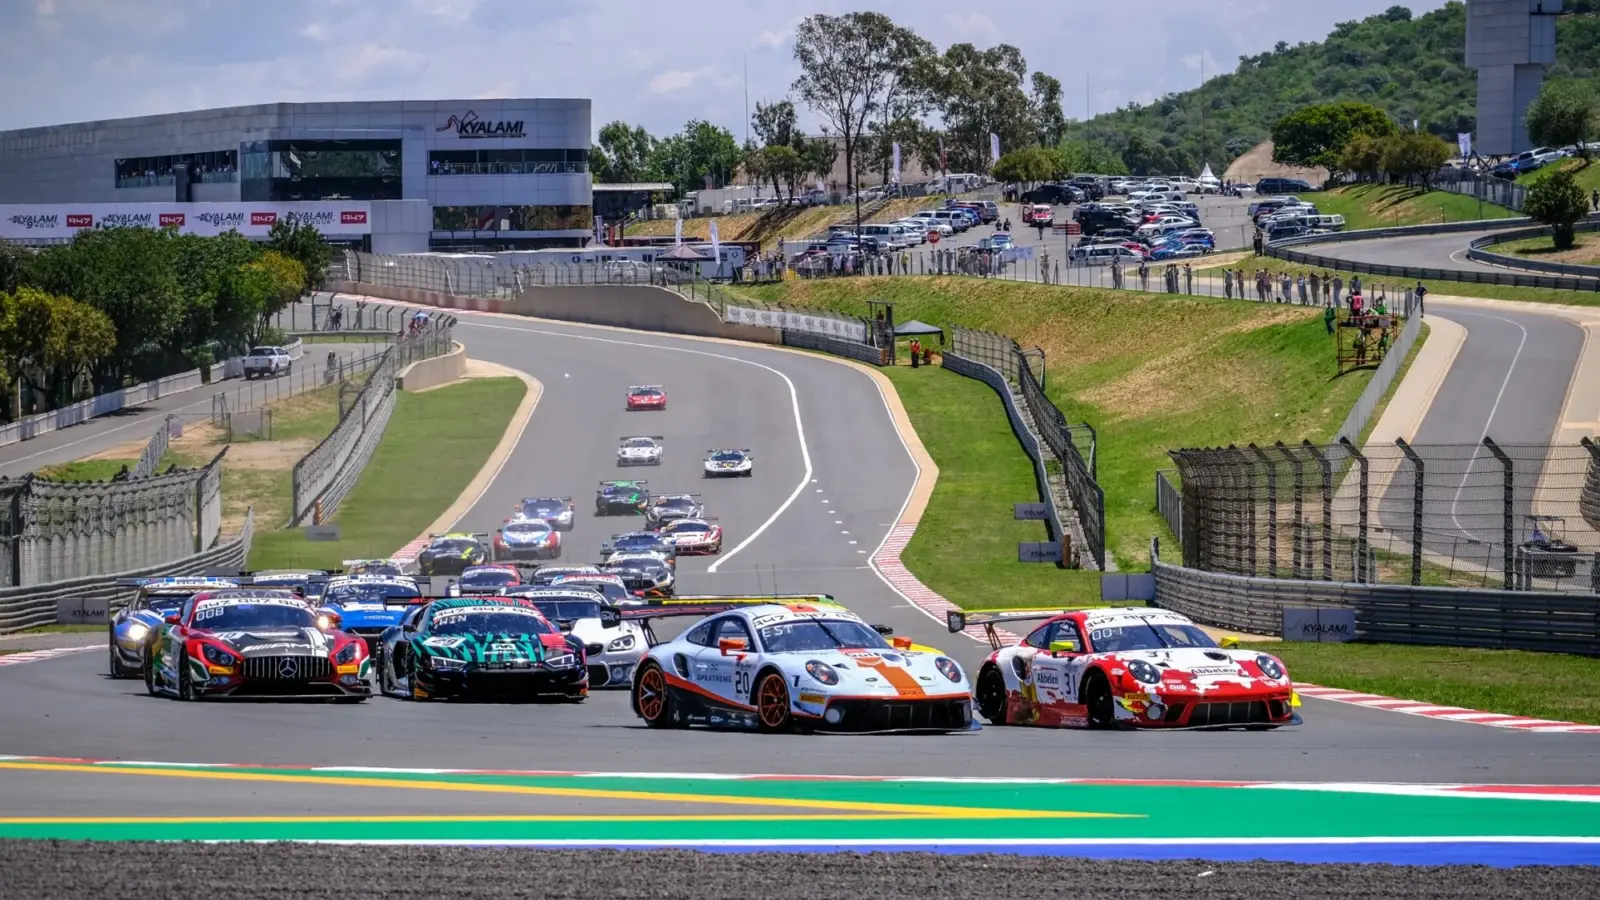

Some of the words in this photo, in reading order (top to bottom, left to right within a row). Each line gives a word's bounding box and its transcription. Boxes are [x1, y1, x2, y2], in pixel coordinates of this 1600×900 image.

[459, 120, 524, 133] KYALAMI
[12, 214, 58, 224] KYALAMI
[68, 217, 91, 225] 947
[160, 216, 183, 224] 947
[200, 212, 244, 222] KYALAMI
[342, 213, 365, 221] 947
[26, 221, 33, 229] 9
[213, 219, 219, 227] 9
[72, 609, 105, 617] KYALAMI
[761, 624, 793, 638] EST
[1302, 624, 1348, 633] KYALAMI
[1190, 667, 1237, 675] Abbelen
[735, 670, 750, 695] 20
[1037, 672, 1059, 685] Abbelen
